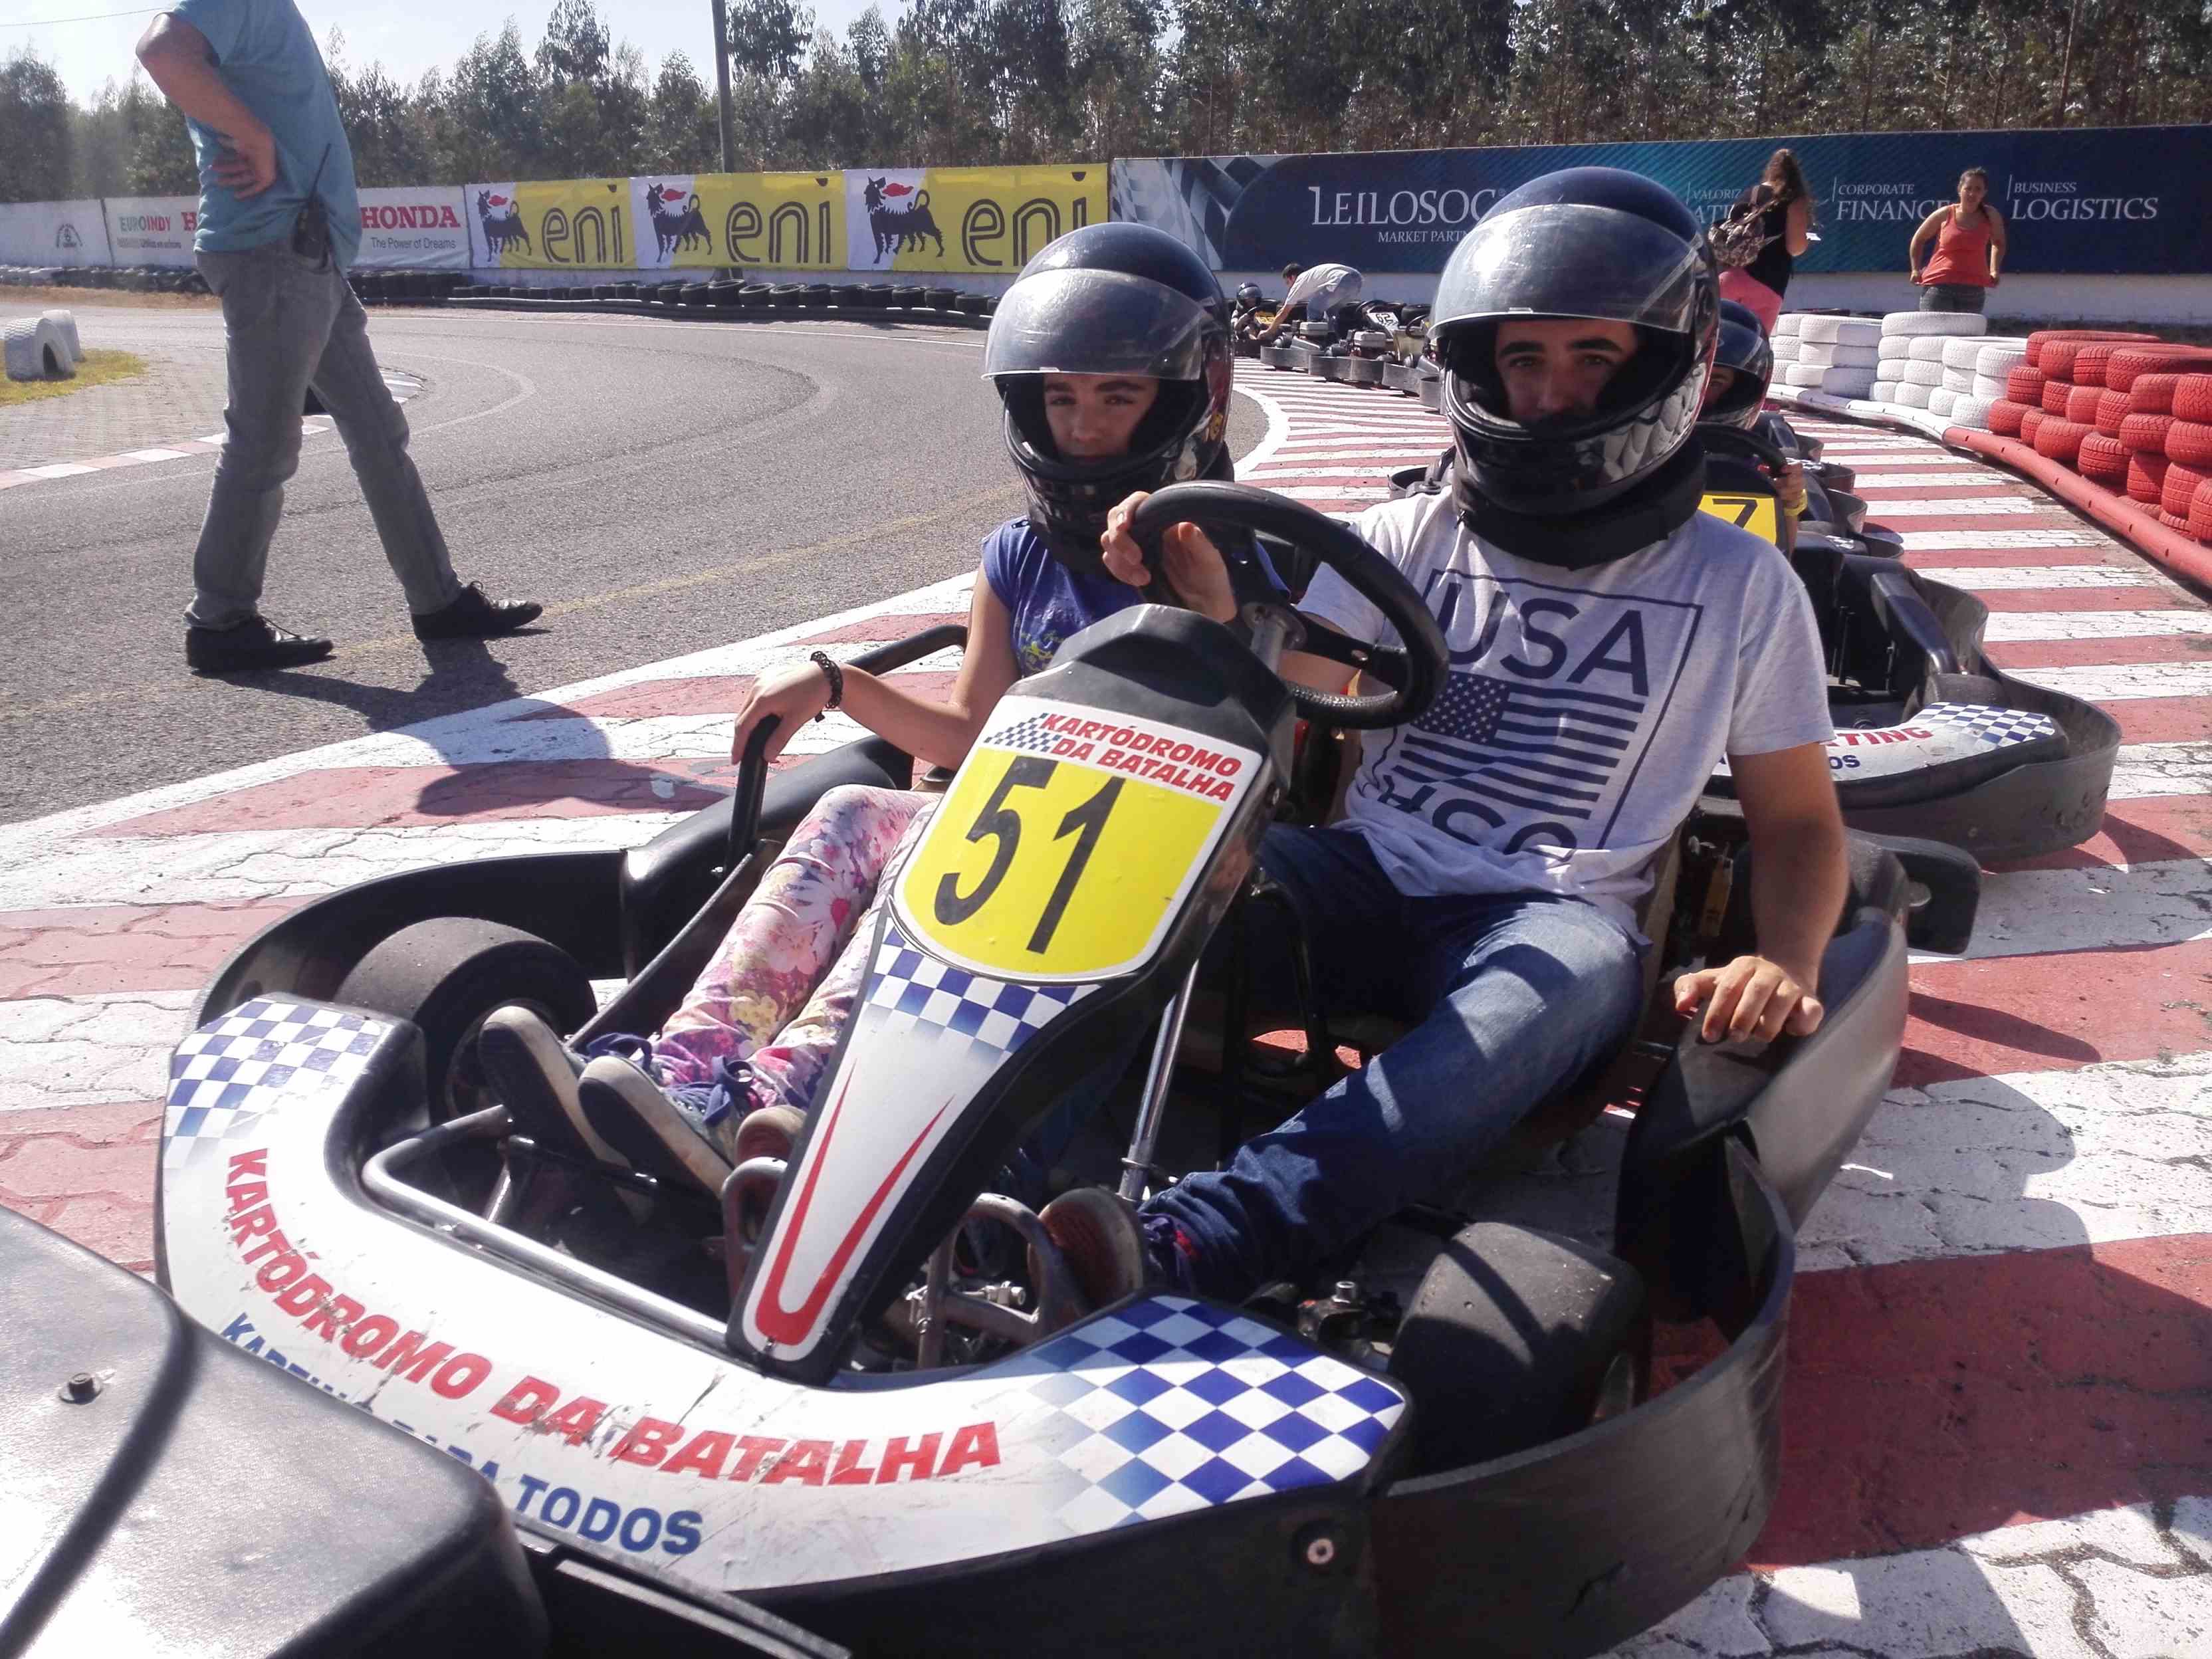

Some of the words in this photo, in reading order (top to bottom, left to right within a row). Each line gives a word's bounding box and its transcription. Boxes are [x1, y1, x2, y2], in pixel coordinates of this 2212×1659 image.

[361, 206, 461, 229] HONDA
[962, 171, 1087, 266] eni
[1838, 183, 1914, 195] CORPORATE
[2011, 197, 2159, 220] LOGISTICS
[2014, 182, 2077, 193] BUSINESS
[371, 237, 386, 249] The
[388, 237, 412, 249] Power
[414, 238, 422, 249] of
[424, 237, 457, 249] Dreams
[542, 183, 623, 263] eni
[726, 177, 831, 263] eni
[1378, 231, 1428, 243] MARKET
[1437, 582, 1649, 697] USA
[1040, 713, 1242, 776] KARTÓDROMO
[1051, 738, 1096, 760] DA
[1097, 748, 1235, 802] BATALHA
[934, 756, 1127, 954] 51
[226, 1148, 493, 1399] KARTÓDROMO
[489, 1375, 608, 1446] DA
[607, 1416, 1000, 1486] BATALHA
[516, 1474, 703, 1555] TODOS
